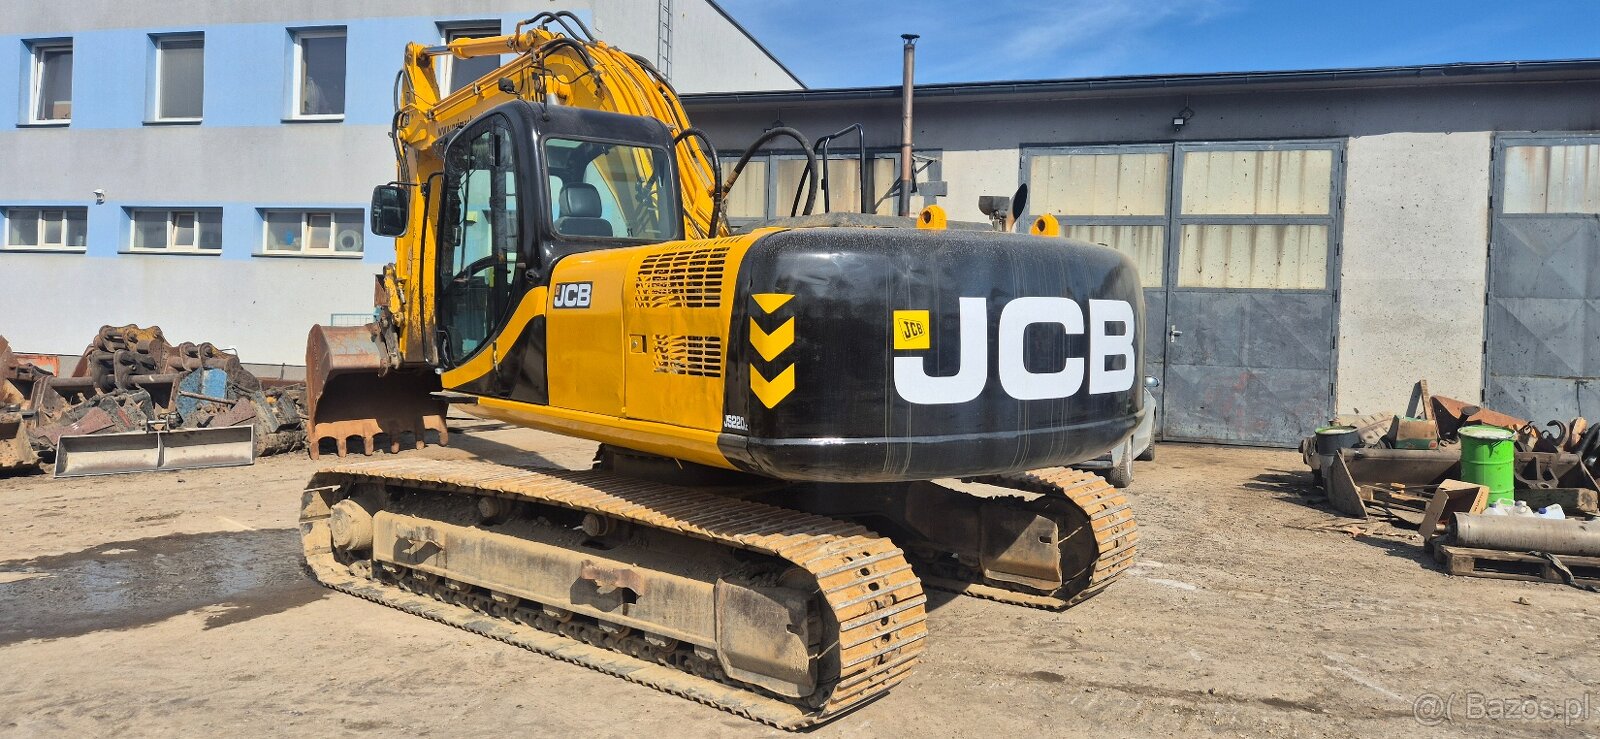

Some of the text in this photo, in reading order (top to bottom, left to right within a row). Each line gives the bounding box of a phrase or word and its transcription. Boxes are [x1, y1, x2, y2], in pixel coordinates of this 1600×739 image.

[554, 284, 591, 307] JCB
[903, 321, 923, 338] JCB
[893, 297, 1136, 405] JCB
